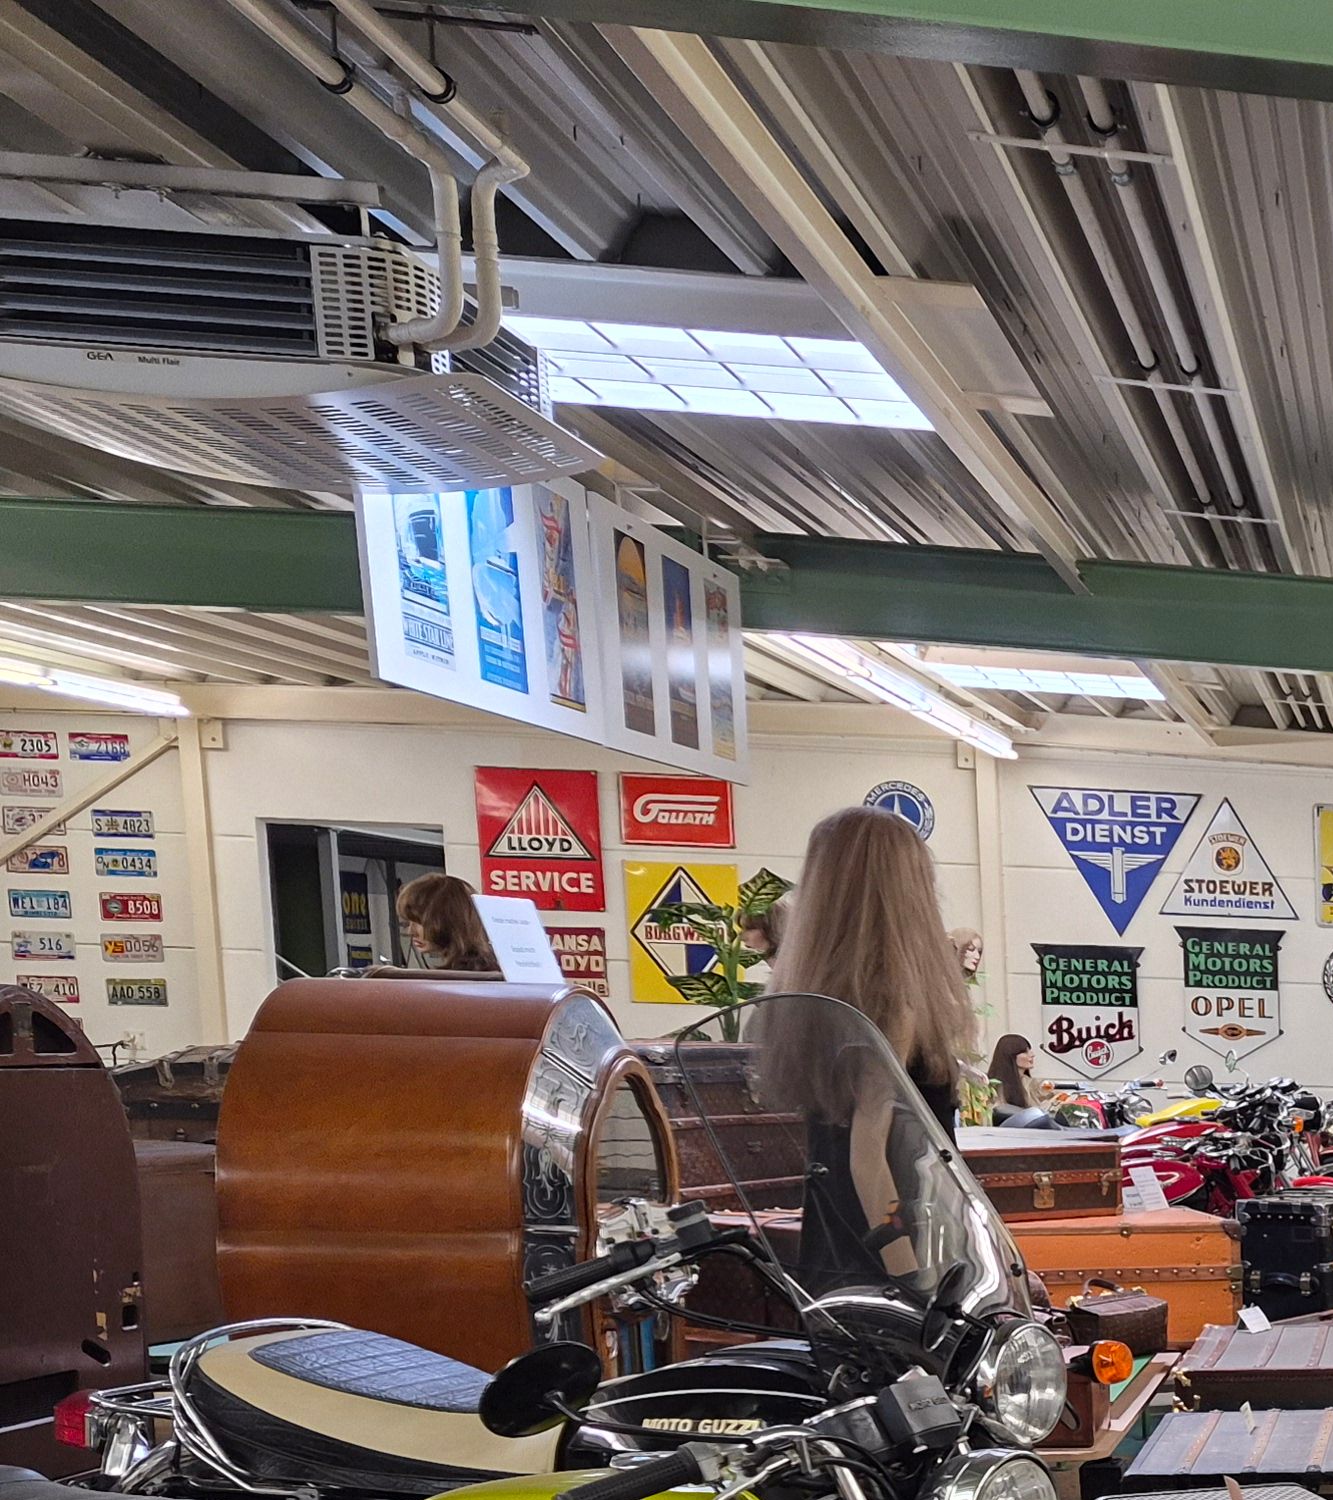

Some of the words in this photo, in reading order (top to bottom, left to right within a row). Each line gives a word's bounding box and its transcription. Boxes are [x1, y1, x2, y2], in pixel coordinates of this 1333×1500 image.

[87, 352, 114, 361] GEA
[865, 780, 926, 804] MERCEDES
[633, 793, 721, 825] GOLIATH
[1051, 791, 1182, 820] ADLER
[506, 834, 574, 854] LLOYD
[1065, 822, 1167, 846] DIENST
[489, 870, 594, 895] SERVICE
[1183, 878, 1275, 898] STOEWER
[1184, 895, 1276, 911] Kundendienst
[551, 932, 604, 953] ANSA
[1186, 937, 1274, 957] GENERAL
[561, 954, 604, 972] OYD
[1042, 954, 1132, 973] GENERAL
[1188, 954, 1274, 973] MOTORS
[1045, 971, 1132, 990] MOTORS
[1188, 970, 1274, 989] PRODUCT
[1045, 988, 1132, 1006] PRODUCT
[1190, 995, 1274, 1019] OPEL
[642, 1417, 692, 1433] MOTO
[698, 1418, 762, 1435] GUZZI
